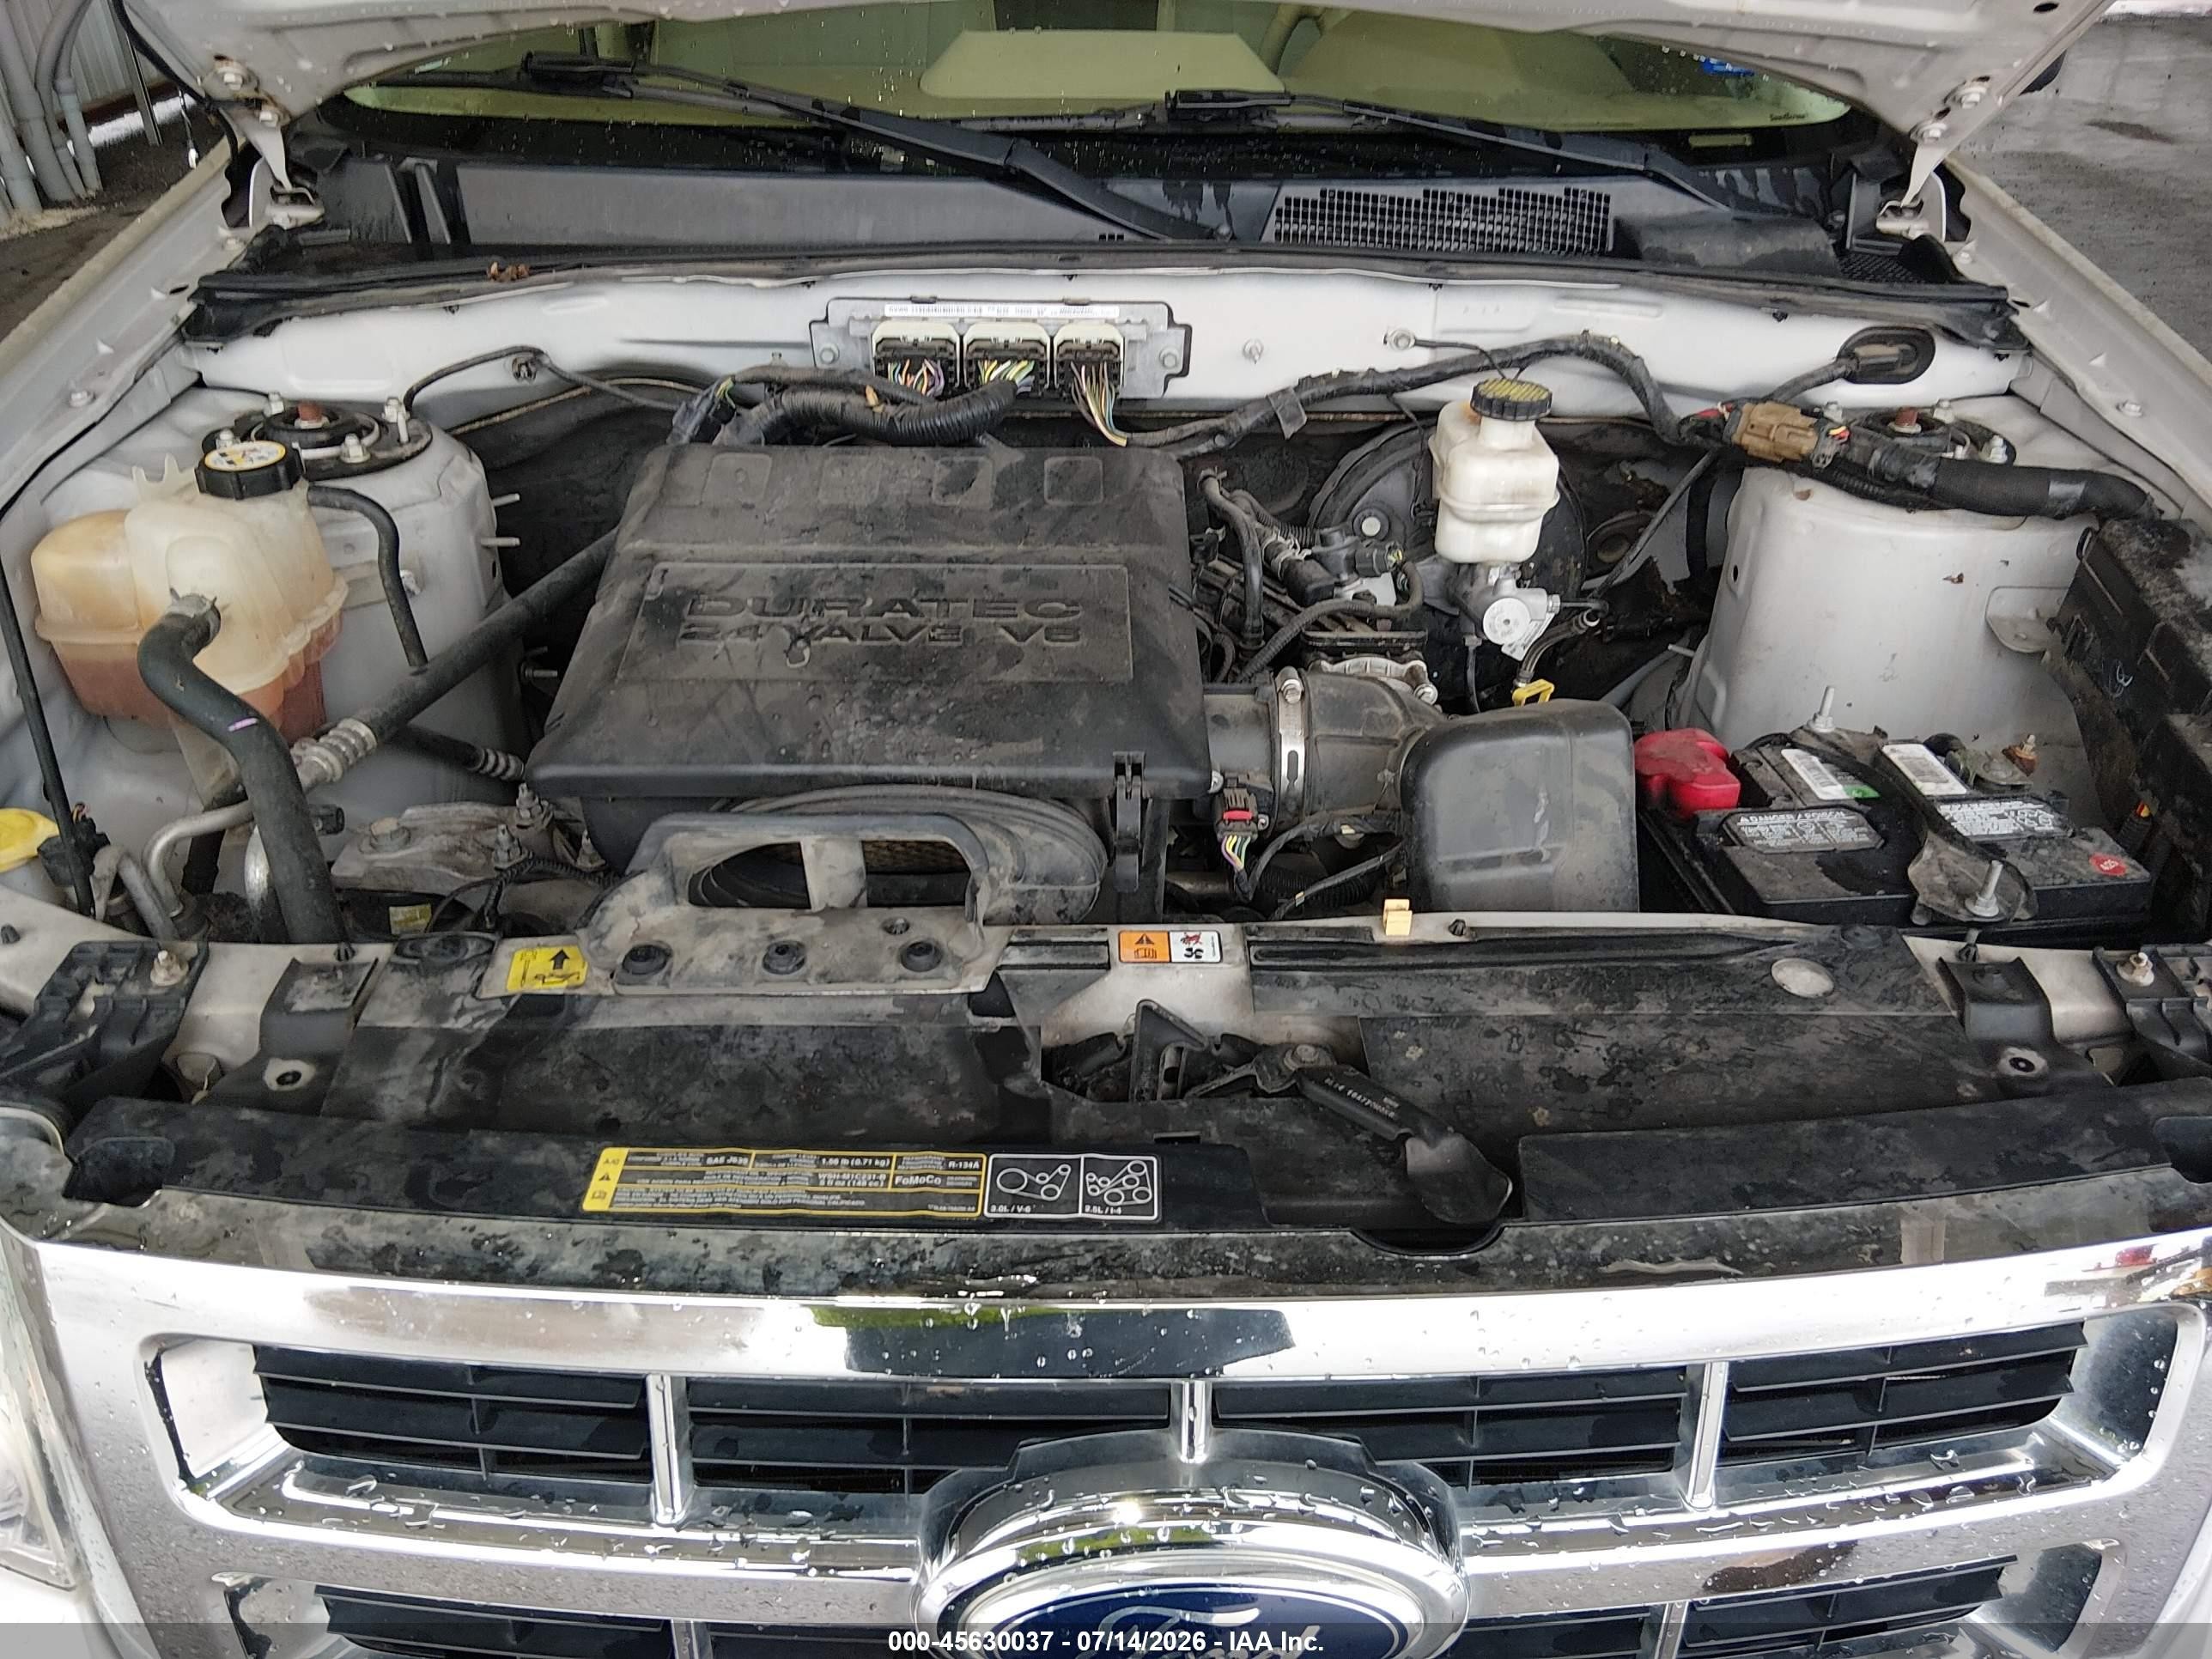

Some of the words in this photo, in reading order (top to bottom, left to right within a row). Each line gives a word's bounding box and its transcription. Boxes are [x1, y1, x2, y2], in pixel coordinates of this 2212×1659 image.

[685, 597, 1084, 619] DURATEC
[948, 1160, 980, 1170] R-134A
[895, 1174, 942, 1185] FoMoCo
